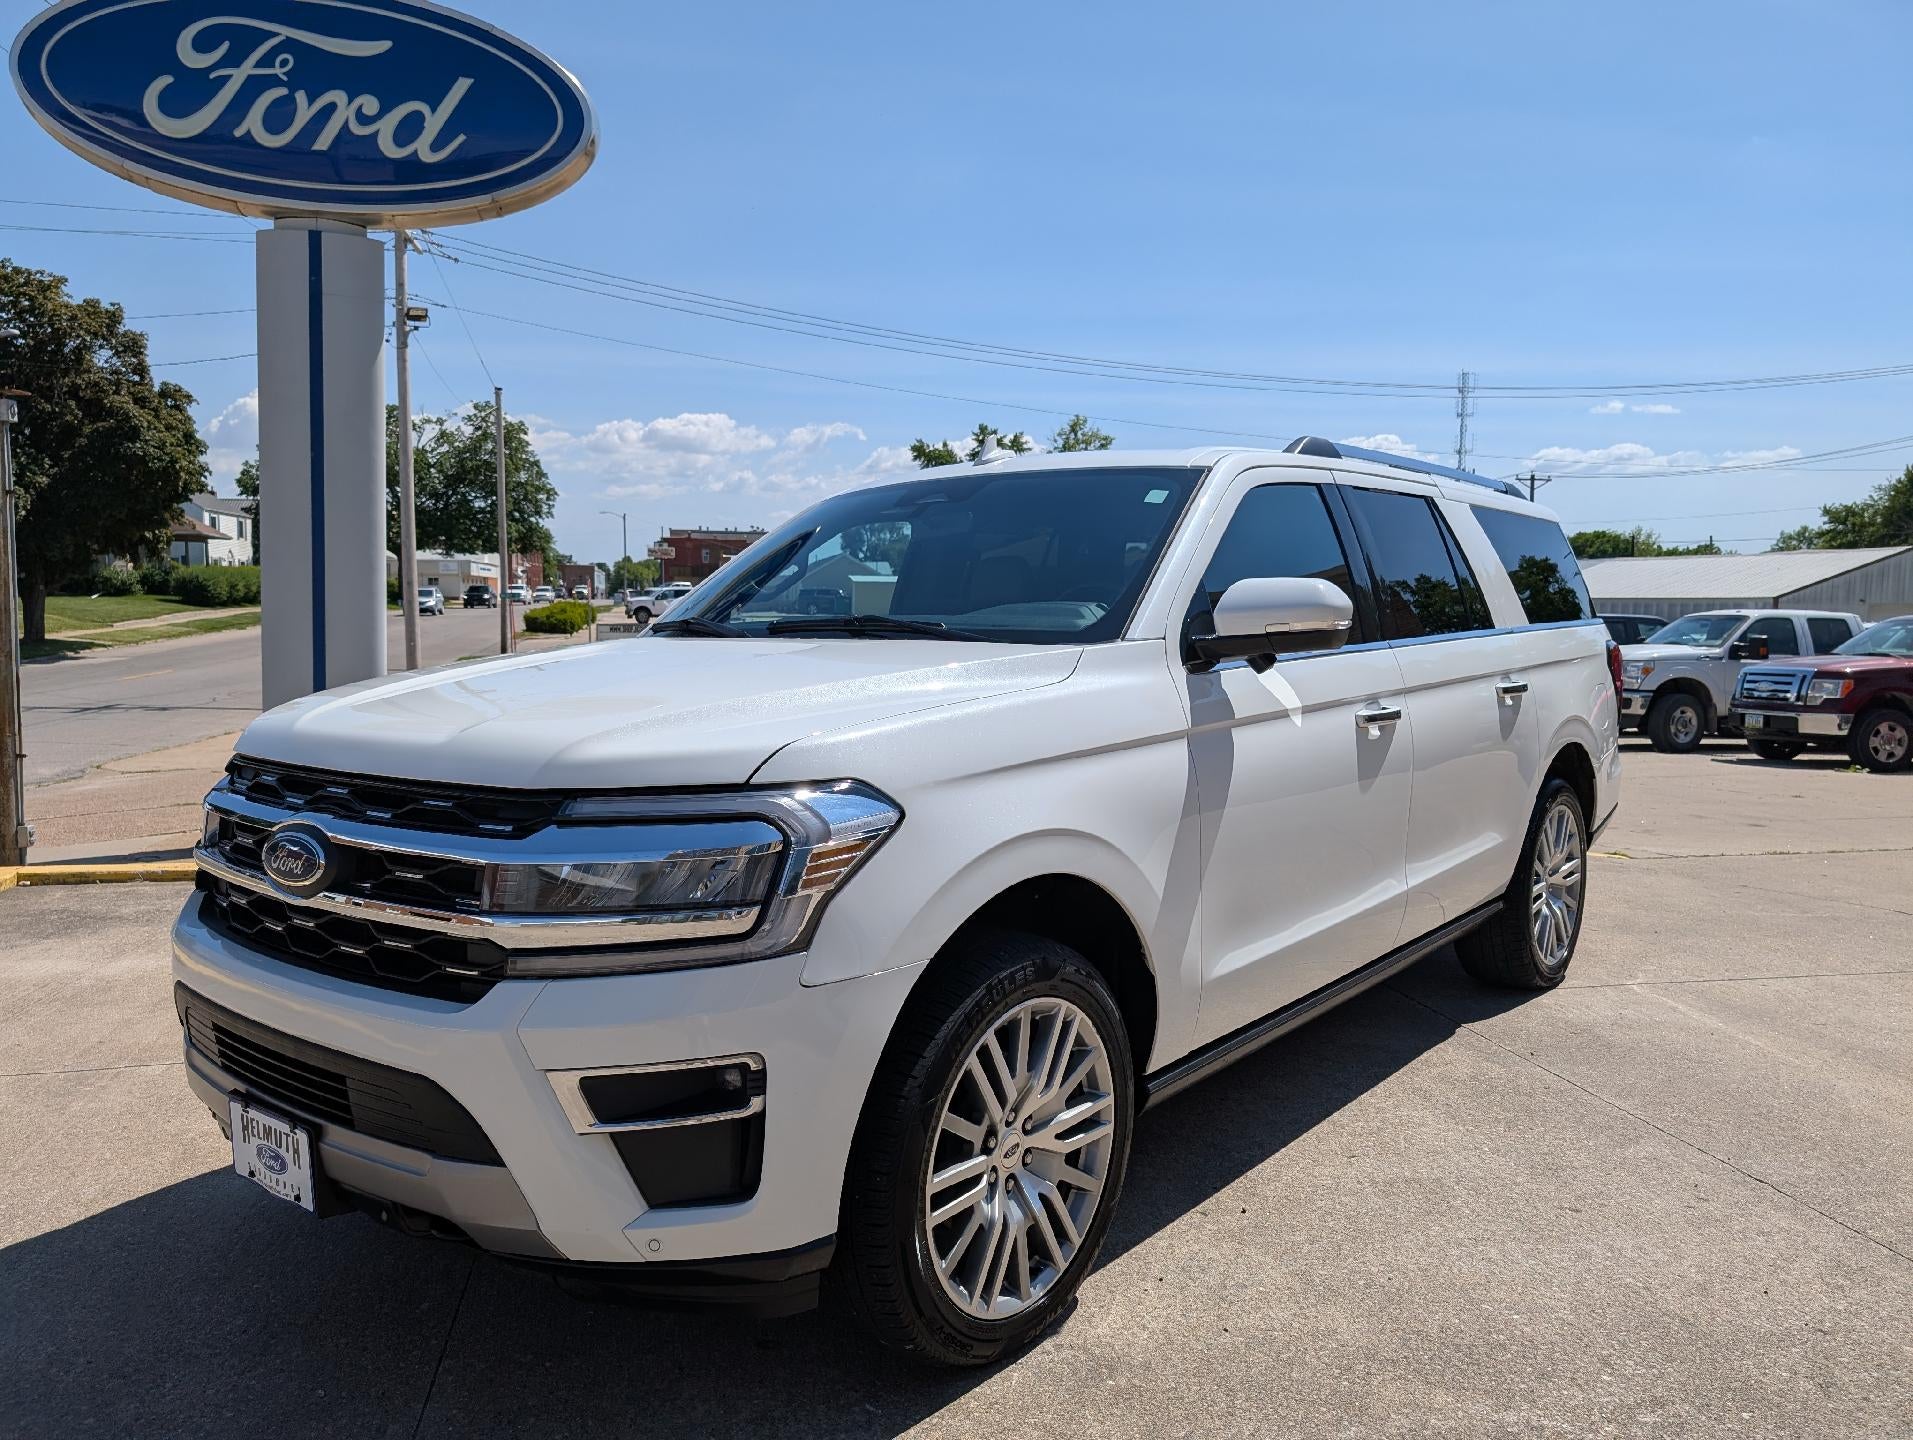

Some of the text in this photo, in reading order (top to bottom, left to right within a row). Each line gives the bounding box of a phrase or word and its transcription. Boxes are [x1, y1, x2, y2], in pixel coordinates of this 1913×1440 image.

[143, 16, 474, 163] Ford
[271, 842, 304, 874] Ford
[240, 1113, 301, 1170] HELMUTH
[260, 1147, 281, 1171] Ford
